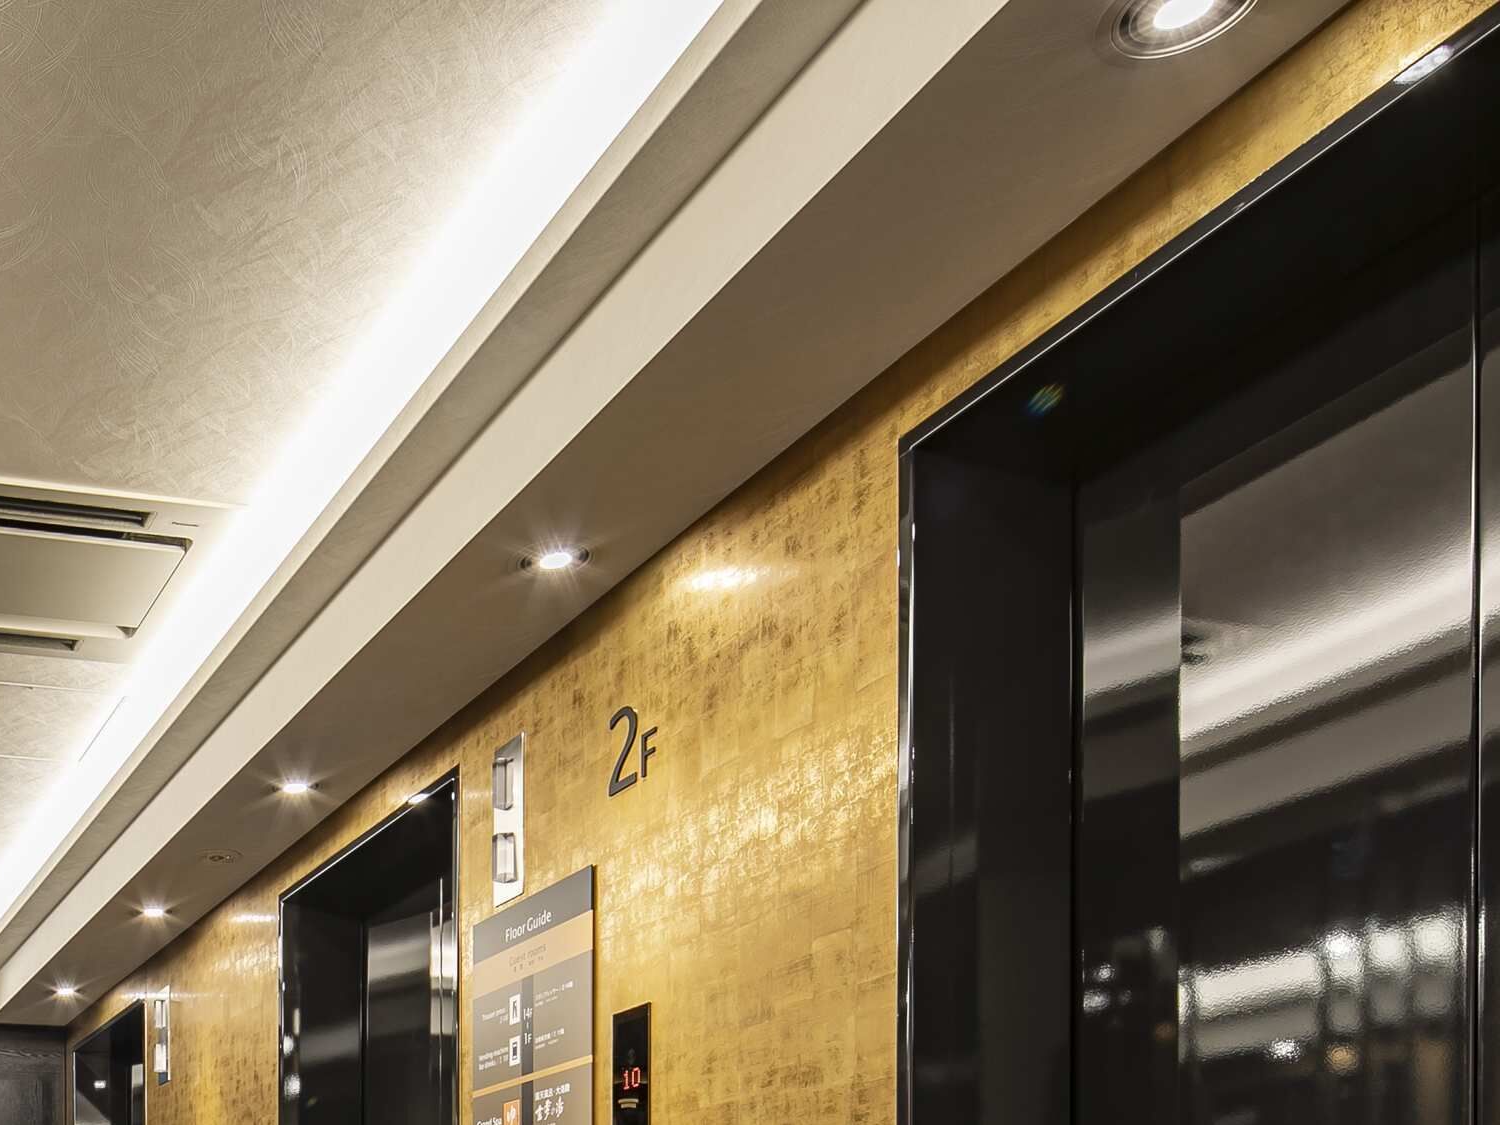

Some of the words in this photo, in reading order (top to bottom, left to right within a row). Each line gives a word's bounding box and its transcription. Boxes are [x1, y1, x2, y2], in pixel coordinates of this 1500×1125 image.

[608, 705, 658, 797] 2F
[505, 923, 525, 942] Floor
[527, 909, 552, 931] Guide
[623, 1067, 641, 1090] 10
